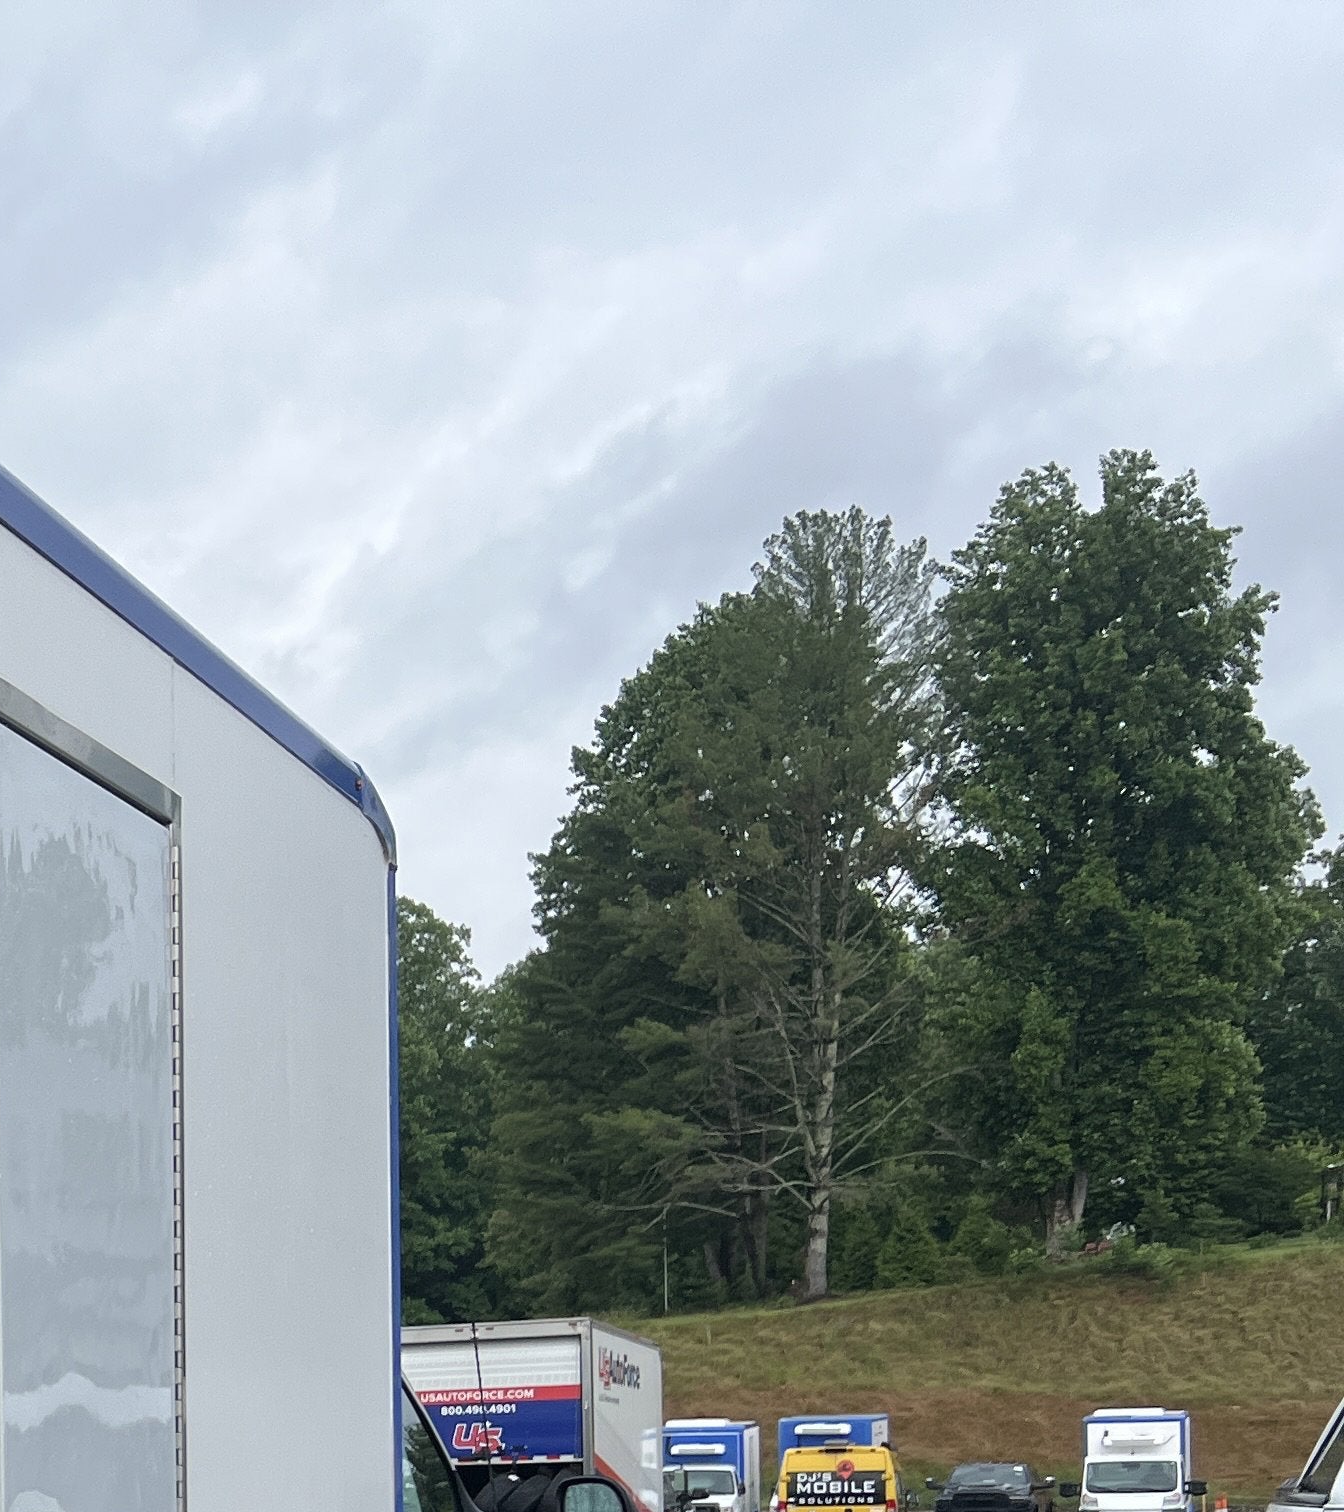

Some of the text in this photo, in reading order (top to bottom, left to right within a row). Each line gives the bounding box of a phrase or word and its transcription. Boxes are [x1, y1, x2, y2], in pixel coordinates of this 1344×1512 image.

[420, 1389, 534, 1403] USAUTOFORCE.COM
[796, 1472, 832, 1483] DJ'S
[796, 1480, 876, 1494] MOBILE
[798, 1496, 874, 1505] SOLUTIONS
